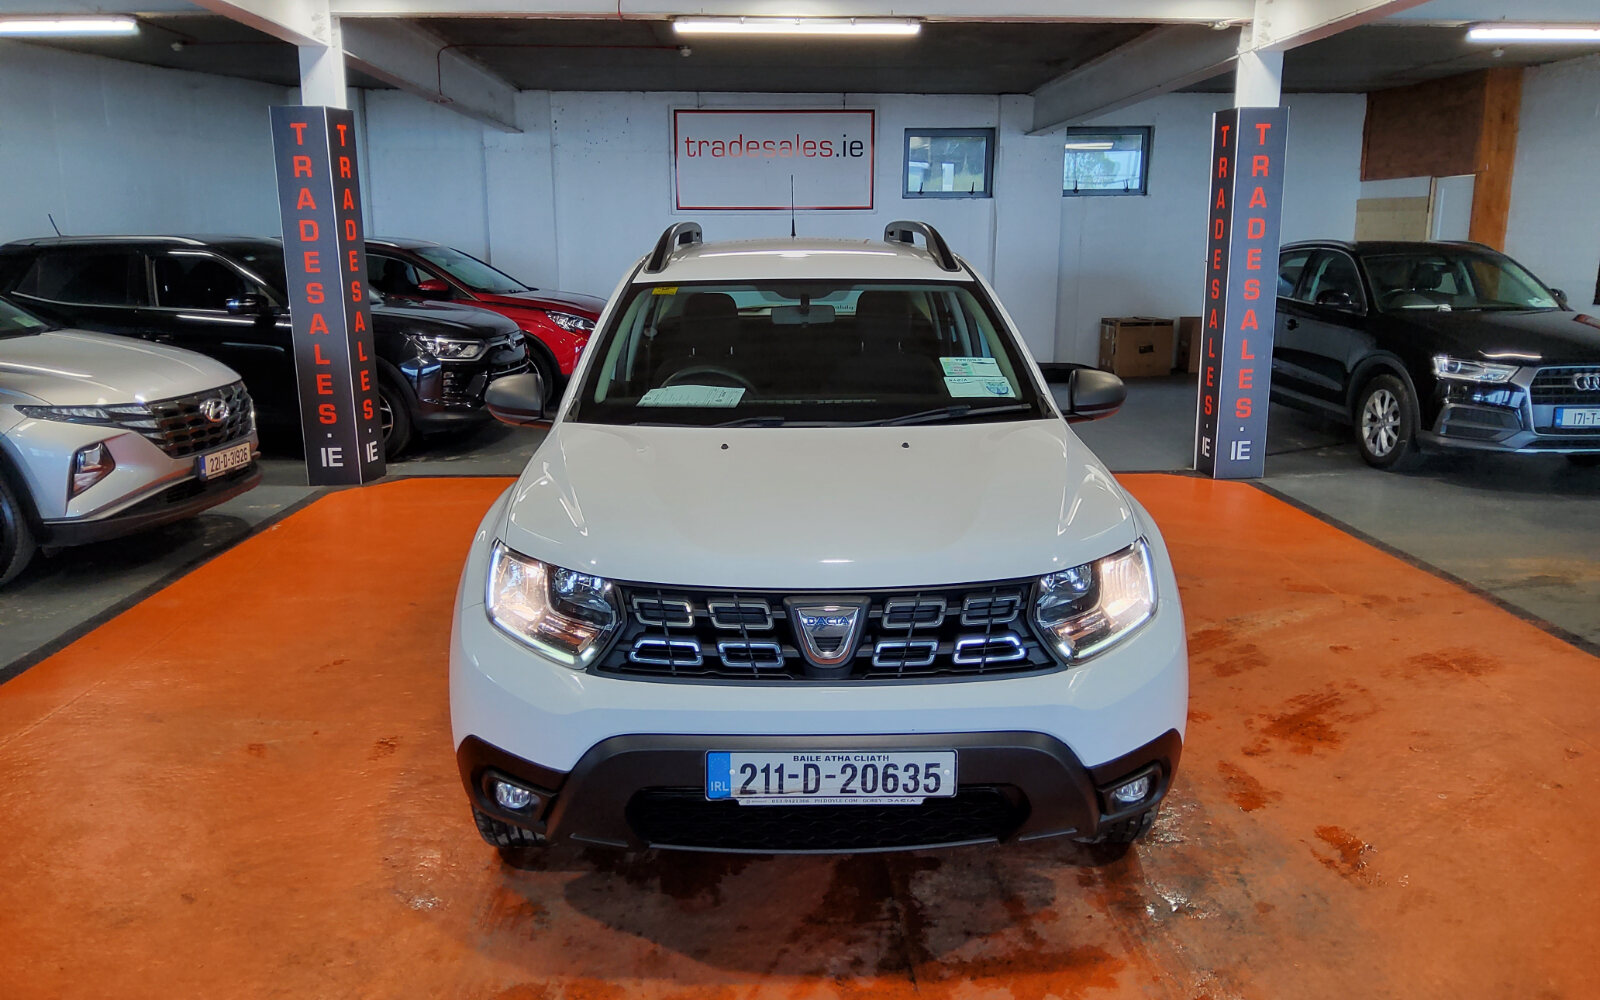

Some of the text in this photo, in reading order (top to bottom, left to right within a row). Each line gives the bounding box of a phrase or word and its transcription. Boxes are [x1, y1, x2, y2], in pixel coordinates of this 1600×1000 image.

[684, 133, 864, 158] tradesales.ie
[209, 447, 248, 473] 221-D-31926
[806, 616, 850, 626] DACIA
[710, 781, 730, 792] IRL
[739, 762, 942, 795] 211-D-20635
